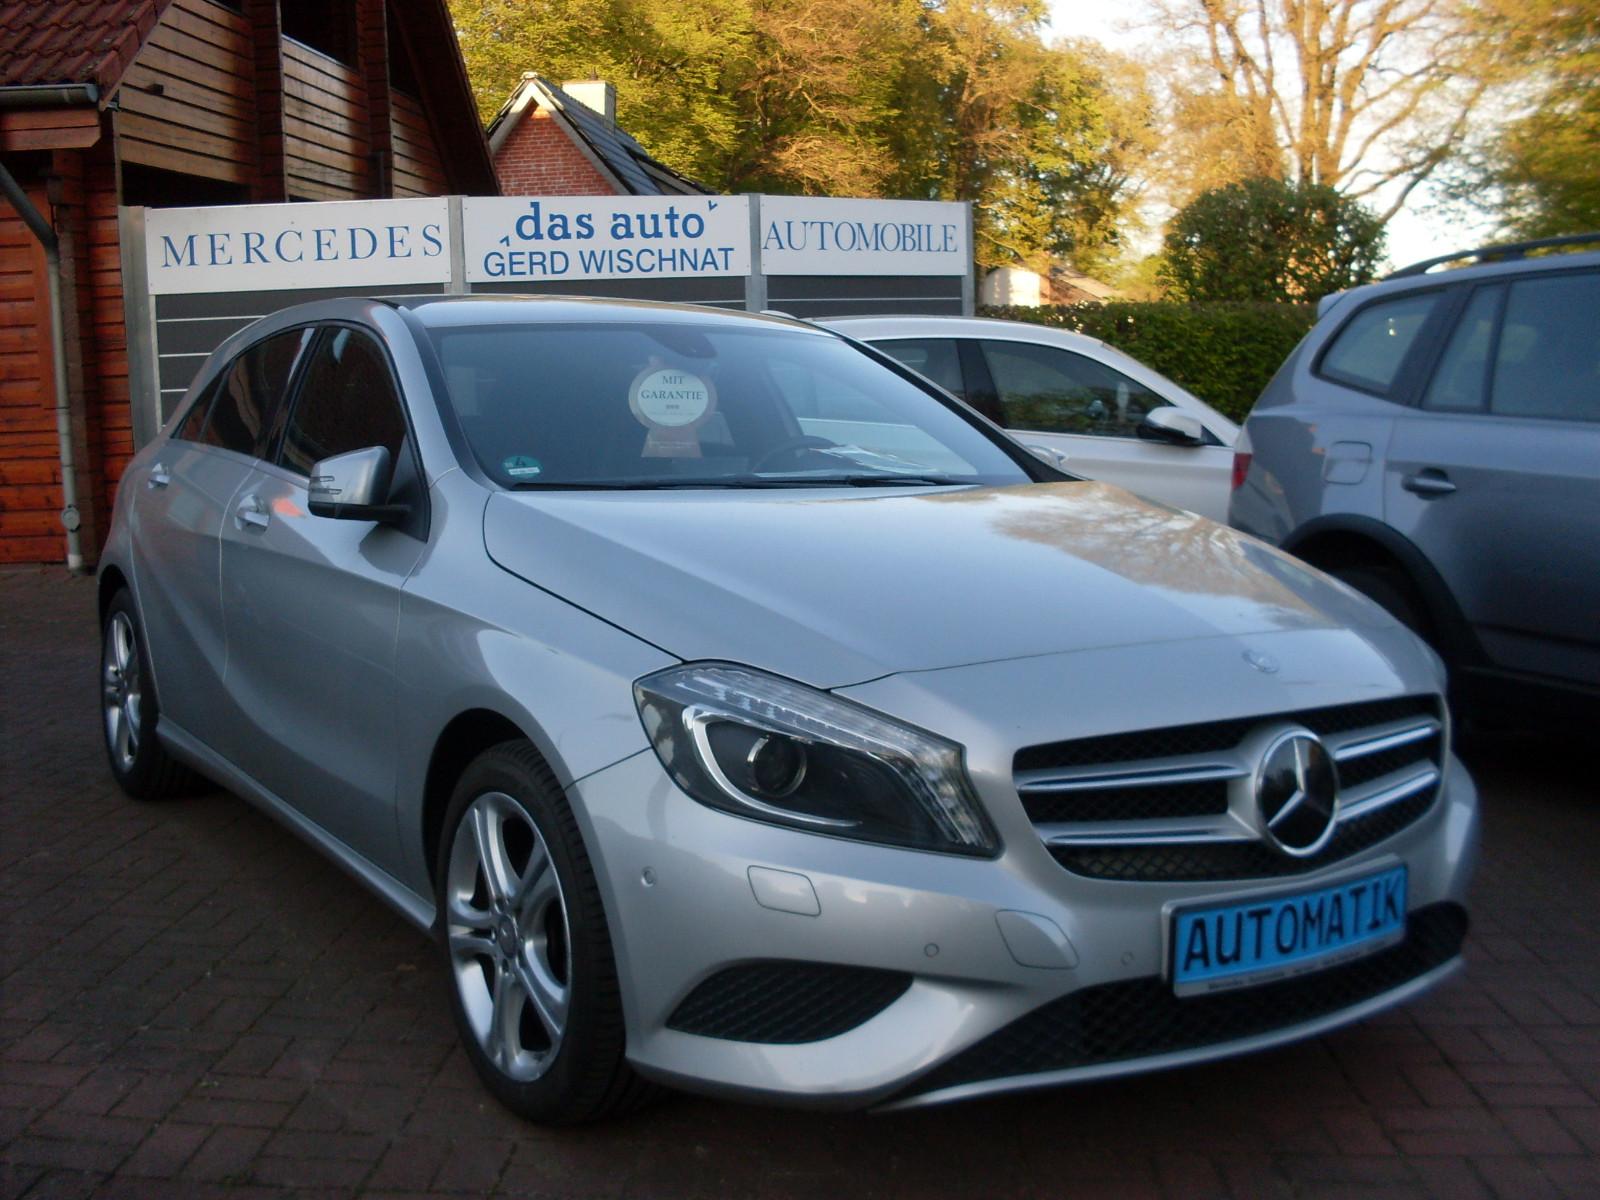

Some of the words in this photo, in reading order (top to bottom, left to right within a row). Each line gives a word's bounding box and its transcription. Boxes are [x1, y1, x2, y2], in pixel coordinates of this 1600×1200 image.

[515, 201, 595, 241] das
[610, 205, 705, 240] auto
[763, 220, 958, 253] AUTOMOBILE
[160, 224, 442, 268] MERCEDES
[484, 251, 569, 277] GERD
[579, 247, 735, 274] WISCHNAT
[641, 390, 703, 401] GARANTIE
[662, 375, 684, 385] MIT
[1184, 879, 1399, 971] AUTOMATIK
